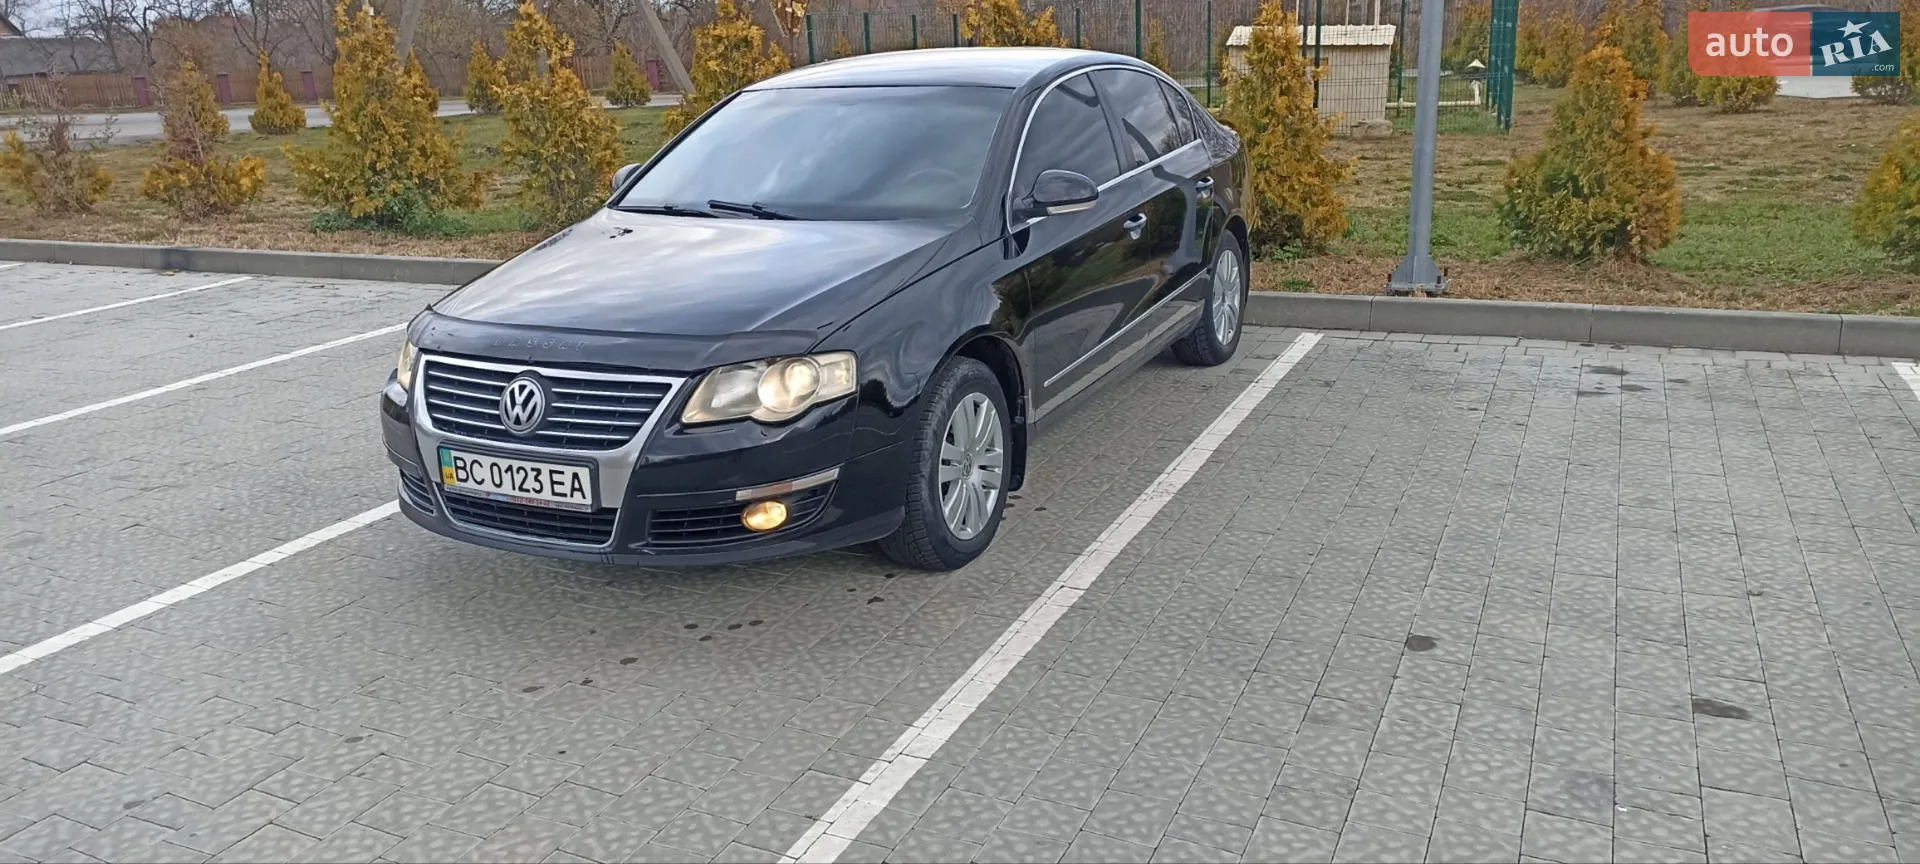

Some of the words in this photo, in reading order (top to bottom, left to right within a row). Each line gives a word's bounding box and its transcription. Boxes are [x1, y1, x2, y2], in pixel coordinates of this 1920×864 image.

[501, 378, 544, 433] VW
[453, 456, 485, 486] BC
[489, 462, 544, 494] 0123
[549, 469, 586, 499] EA
